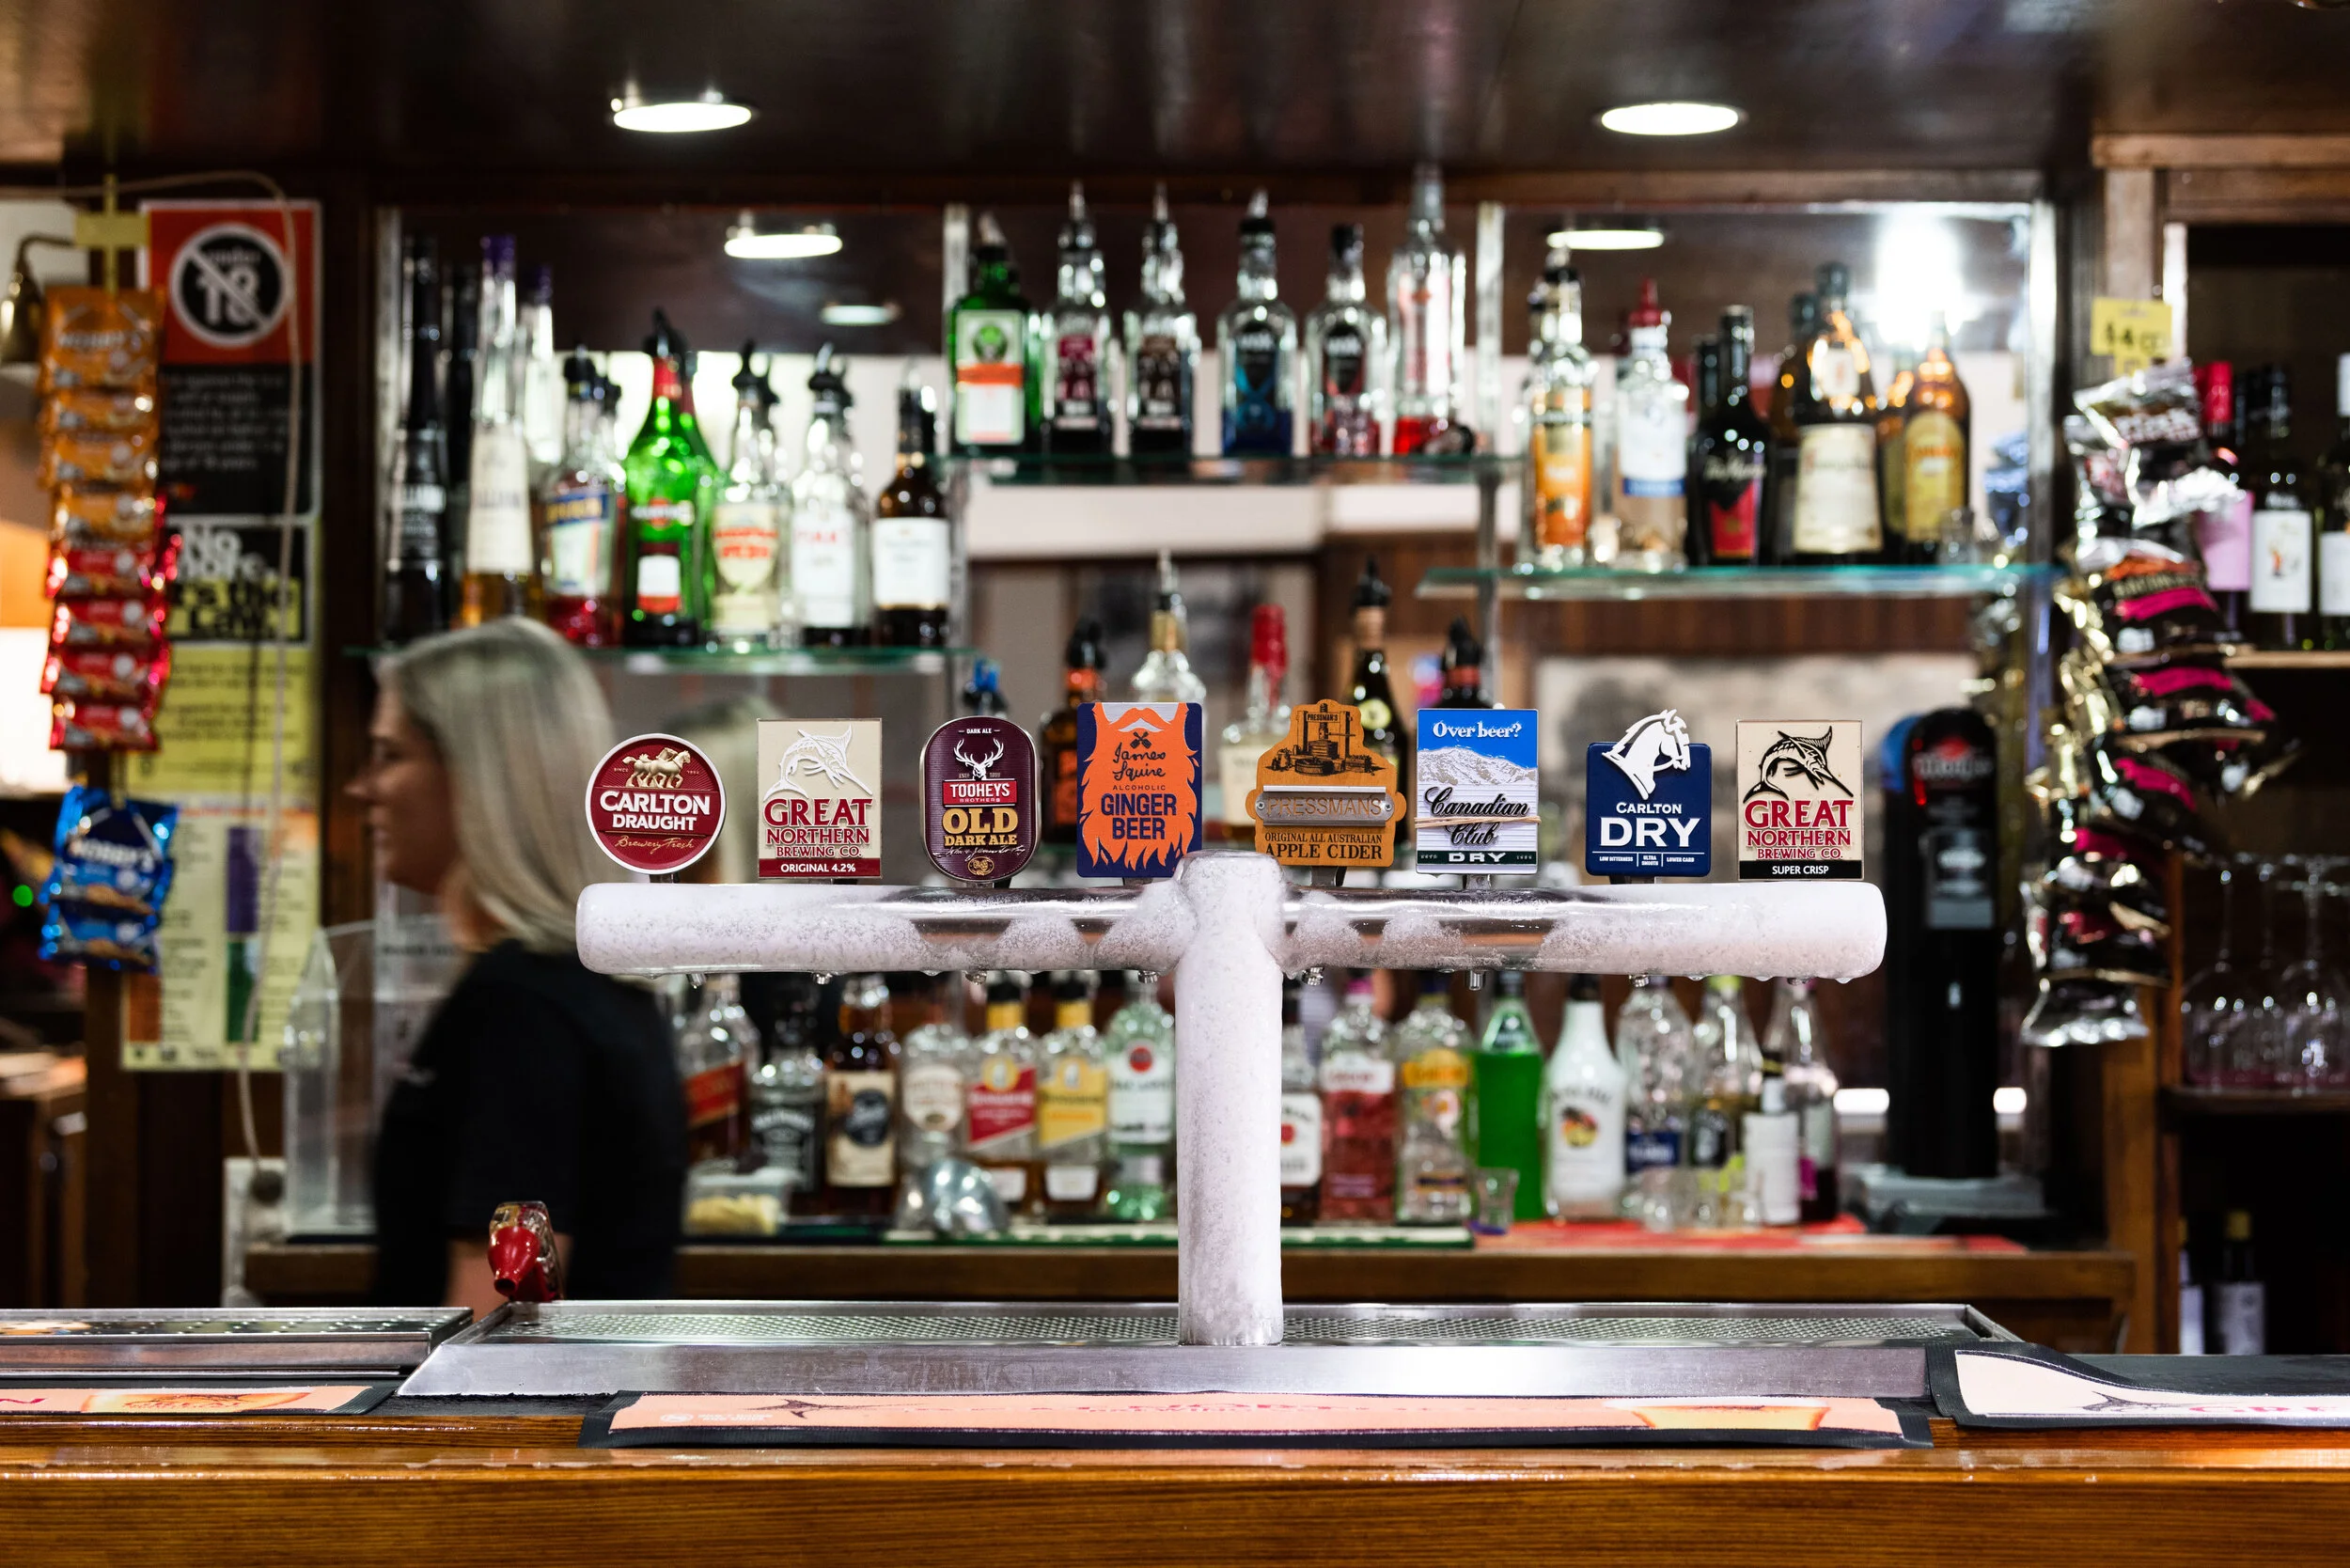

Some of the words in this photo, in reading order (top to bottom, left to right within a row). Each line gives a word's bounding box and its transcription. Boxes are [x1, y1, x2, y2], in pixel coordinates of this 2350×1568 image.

[1433, 720, 1476, 738] Over
[1478, 720, 1523, 738] beer?
[1113, 742, 1166, 763] James
[1112, 760, 1166, 781] Squire
[950, 782, 1010, 798] TOOHEYS
[600, 791, 711, 815] CARLTON
[1101, 793, 1177, 816] GINGER
[1424, 786, 1530, 816] Canadian
[1616, 802, 1682, 814] CARLTON
[764, 798, 873, 826] GREAT
[942, 808, 1019, 834] OLD
[1744, 799, 1855, 828] GREAT
[612, 813, 697, 831] DRAUGHT
[1112, 818, 1166, 839] BEER
[766, 828, 870, 844] NORTHERN
[945, 835, 986, 846] DARK
[989, 834, 1017, 845] ALE
[1265, 832, 1308, 842] ORIGINAL
[1308, 833, 1325, 842] ALL
[1327, 834, 1382, 843] AUSTRALIAN
[1445, 821, 1501, 845] Club
[1600, 817, 1700, 847] DRY
[1747, 830, 1851, 846] NORTHERN
[615, 836, 662, 855] Brewery
[658, 838, 694, 848] Fresh
[776, 846, 835, 857] BREWING
[839, 846, 862, 857] CO.
[1265, 843, 1320, 858] APPLE
[1327, 844, 1383, 859] CIDER
[1757, 848, 1816, 859] BREWING
[1821, 848, 1843, 858] CO.
[1449, 853, 1506, 862] DRY
[780, 864, 829, 872] ORIGINAL
[832, 864, 856, 872] 4.2%
[1772, 866, 1801, 874] SUPER
[1803, 866, 1829, 874] CRISP
